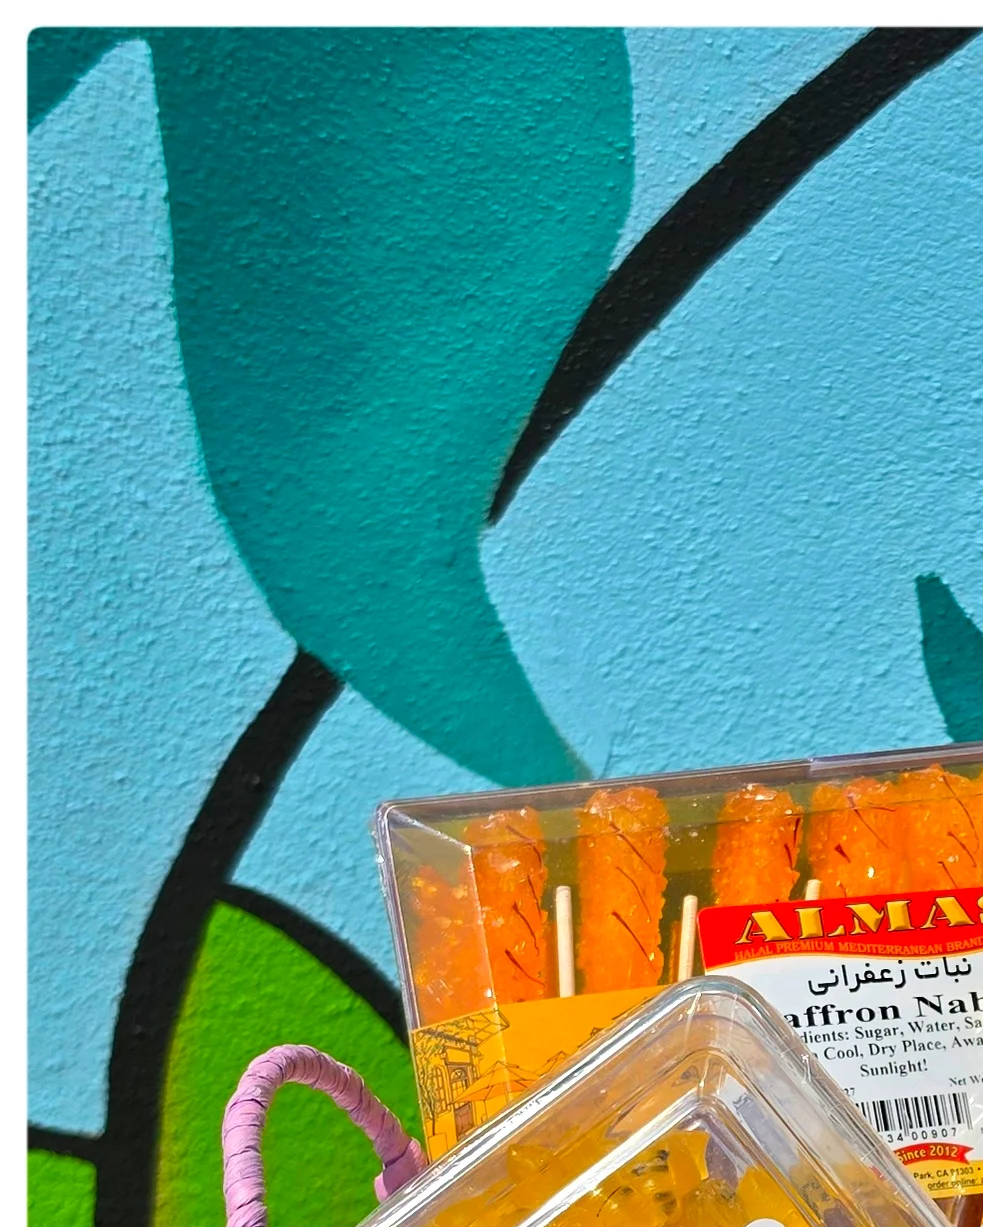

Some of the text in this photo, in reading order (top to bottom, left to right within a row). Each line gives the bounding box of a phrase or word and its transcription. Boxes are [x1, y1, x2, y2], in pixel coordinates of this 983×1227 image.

[735, 944, 774, 962] HALAL
[776, 941, 834, 952] PREMIUM
[838, 942, 943, 956] MEDITERRANEAN
[808, 957, 972, 996] نبات زعفرانی
[783, 1004, 902, 1029] affron
[800, 1031, 850, 1045] dients:
[854, 1026, 905, 1041] Sugar,
[908, 1020, 960, 1034] Water,
[824, 1045, 864, 1061] Cool,
[868, 1043, 897, 1058] Dry
[902, 1039, 947, 1053] Place,
[860, 1059, 928, 1077] Sunlight!
[949, 1077, 967, 1087] Net
[897, 1145, 959, 1163] Since 2012
[936, 1169, 949, 1178] CA
[928, 1179, 950, 1190] order
